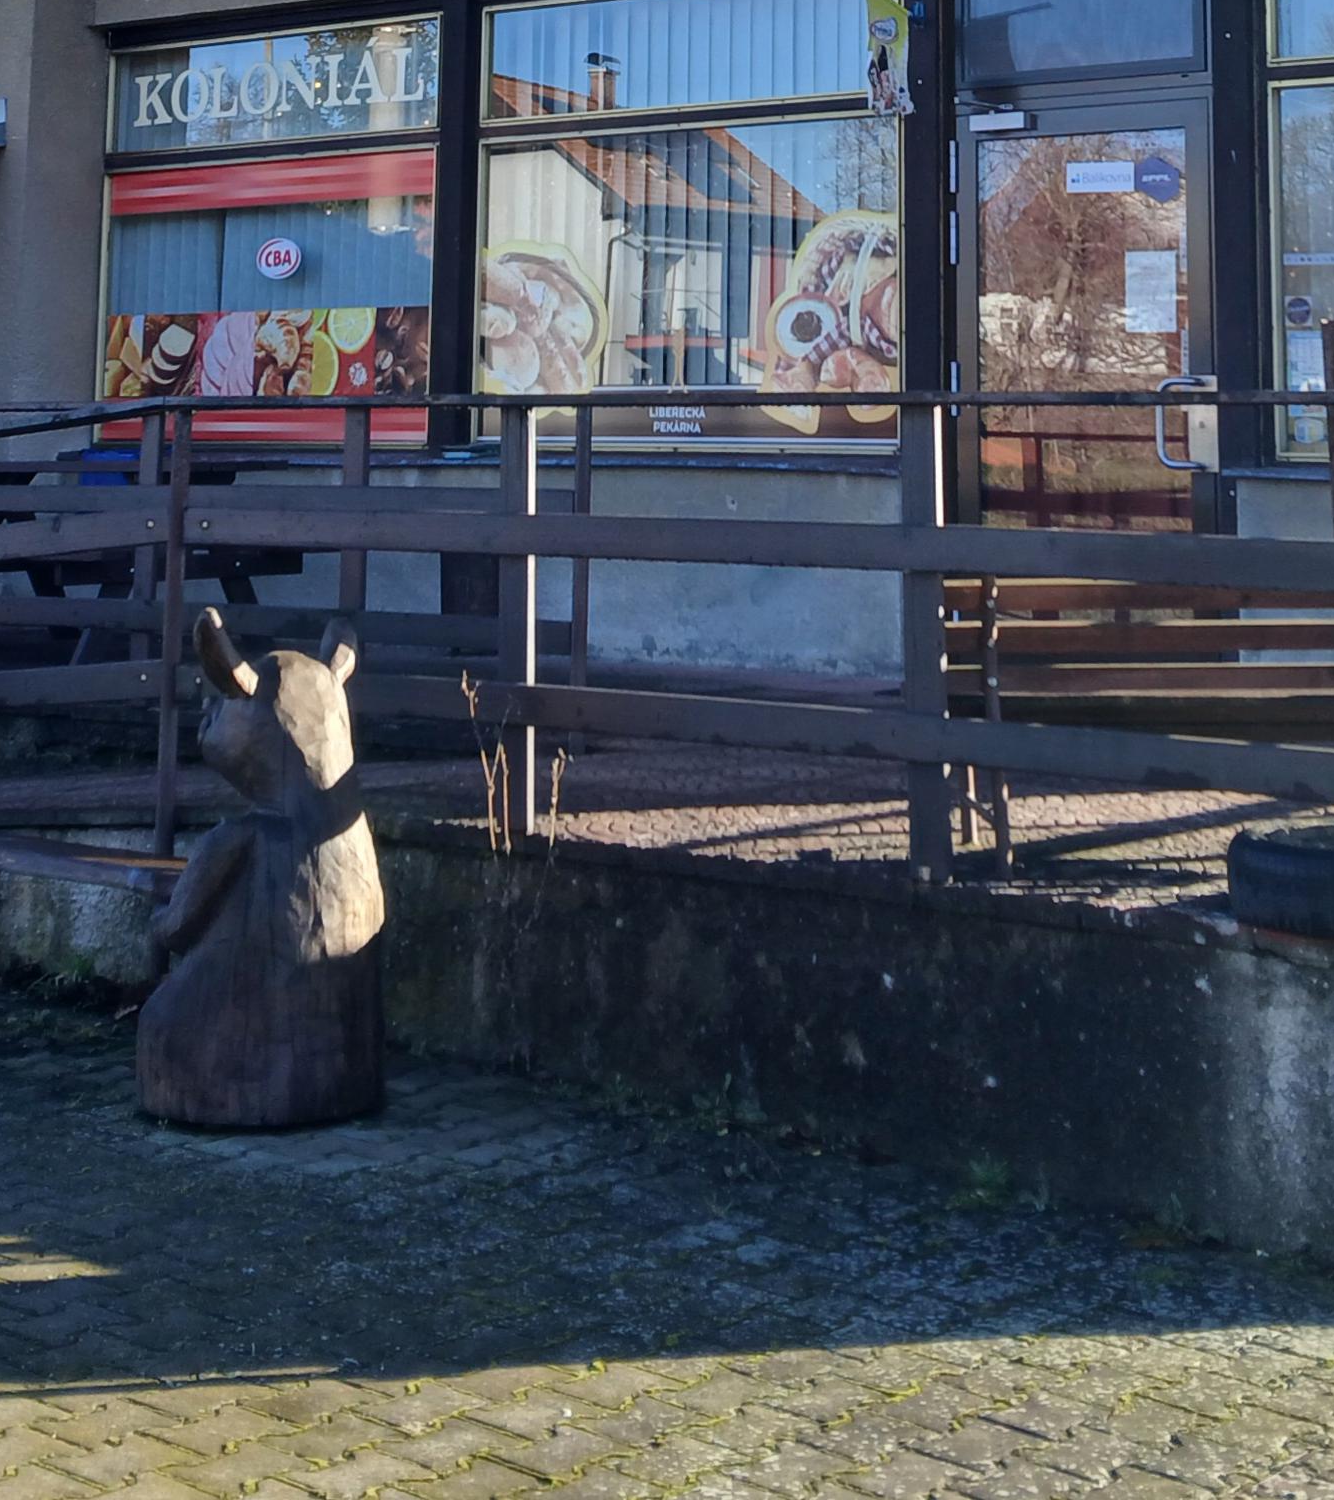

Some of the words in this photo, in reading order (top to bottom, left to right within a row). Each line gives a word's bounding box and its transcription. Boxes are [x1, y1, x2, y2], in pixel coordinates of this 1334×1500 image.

[133, 36, 425, 128] KOLONIÁL
[265, 249, 292, 268] CBA
[653, 420, 702, 434] PEKÁRNA
